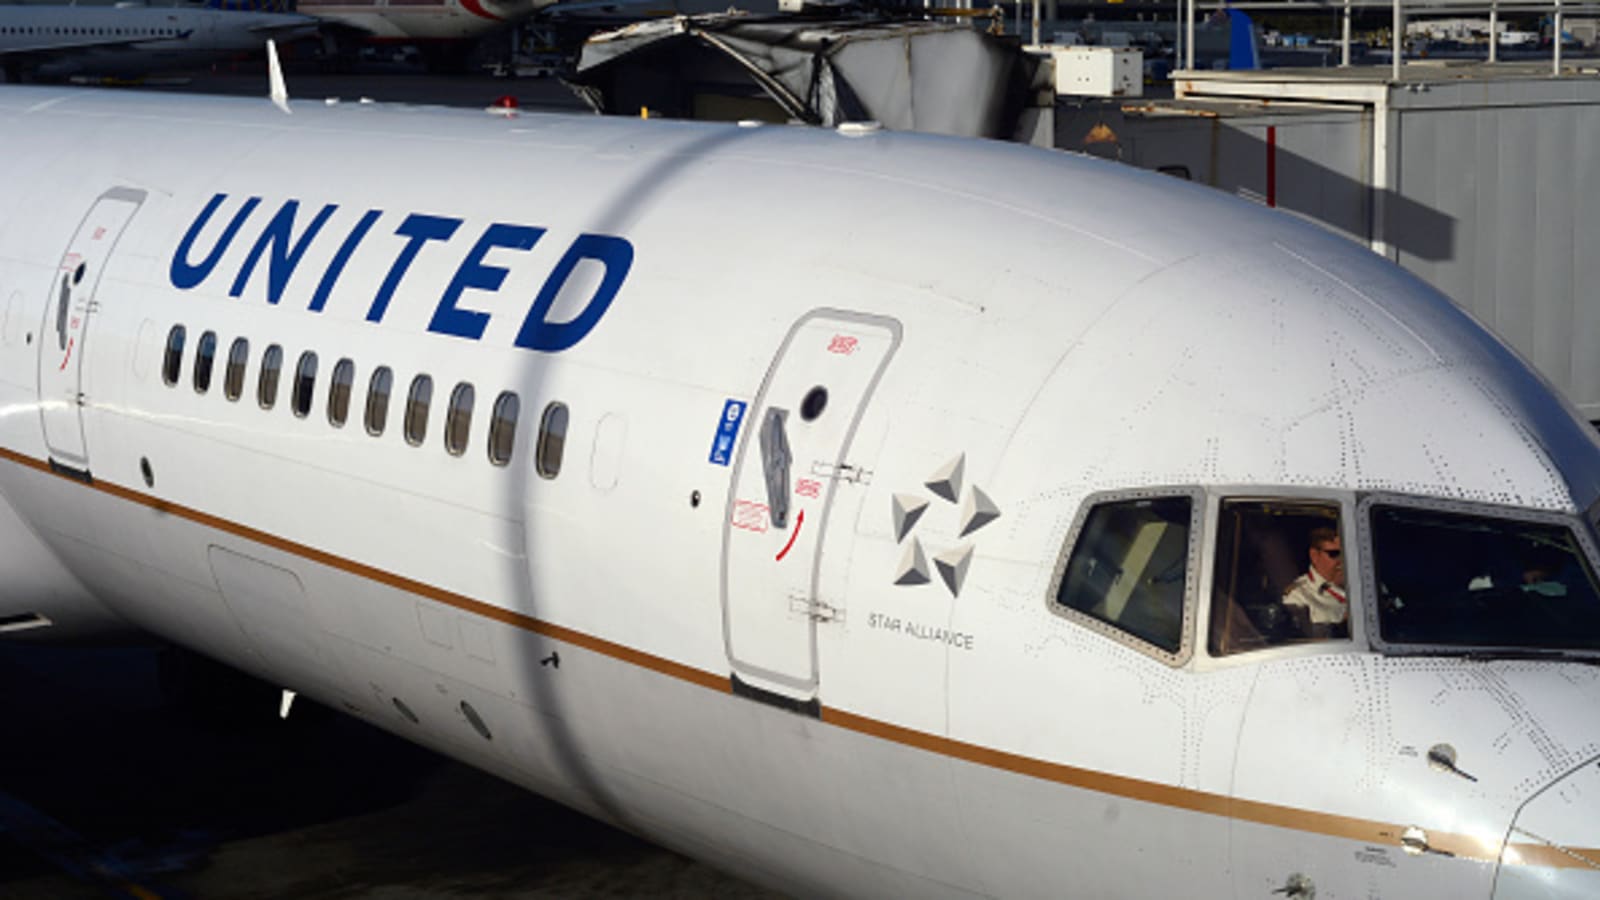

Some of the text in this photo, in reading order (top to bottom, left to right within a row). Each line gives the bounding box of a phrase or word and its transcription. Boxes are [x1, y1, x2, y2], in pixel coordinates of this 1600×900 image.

[169, 193, 635, 353] UNITED
[868, 612, 974, 650] STAR ALLIANCE
